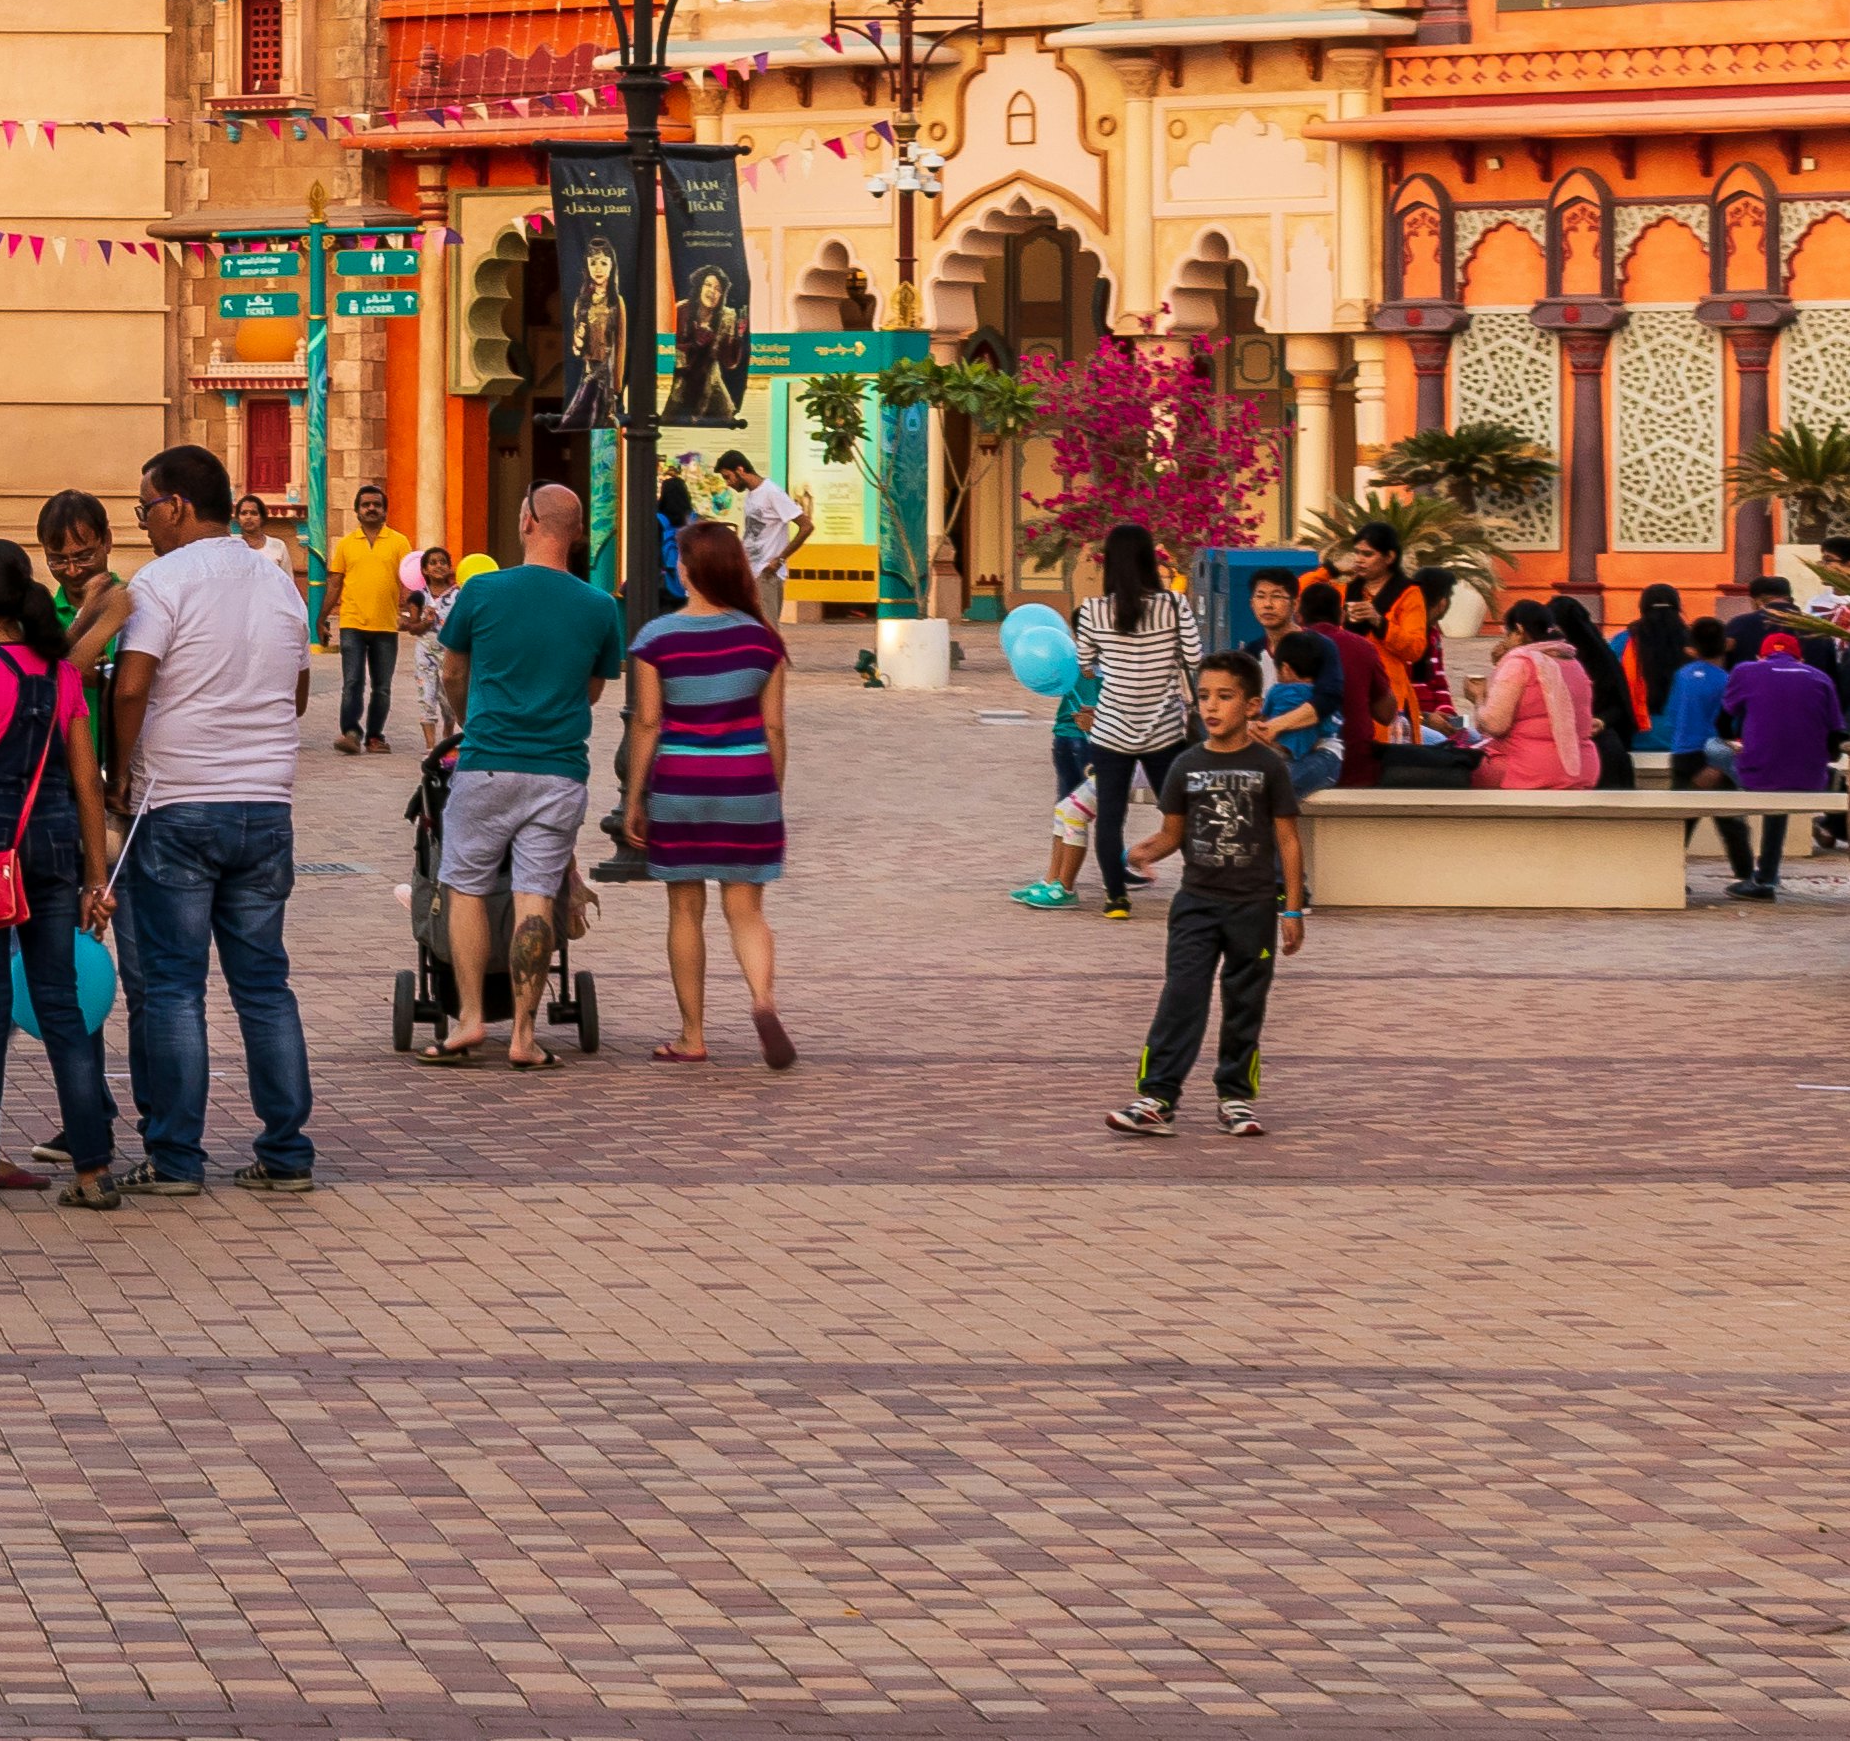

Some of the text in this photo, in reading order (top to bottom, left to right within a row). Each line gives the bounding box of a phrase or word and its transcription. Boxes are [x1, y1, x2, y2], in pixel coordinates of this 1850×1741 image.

[687, 179, 720, 192] JAAN
[688, 200, 725, 214] JIGAR
[245, 307, 275, 316] TICKETS
[362, 304, 396, 314] LOCKERS
